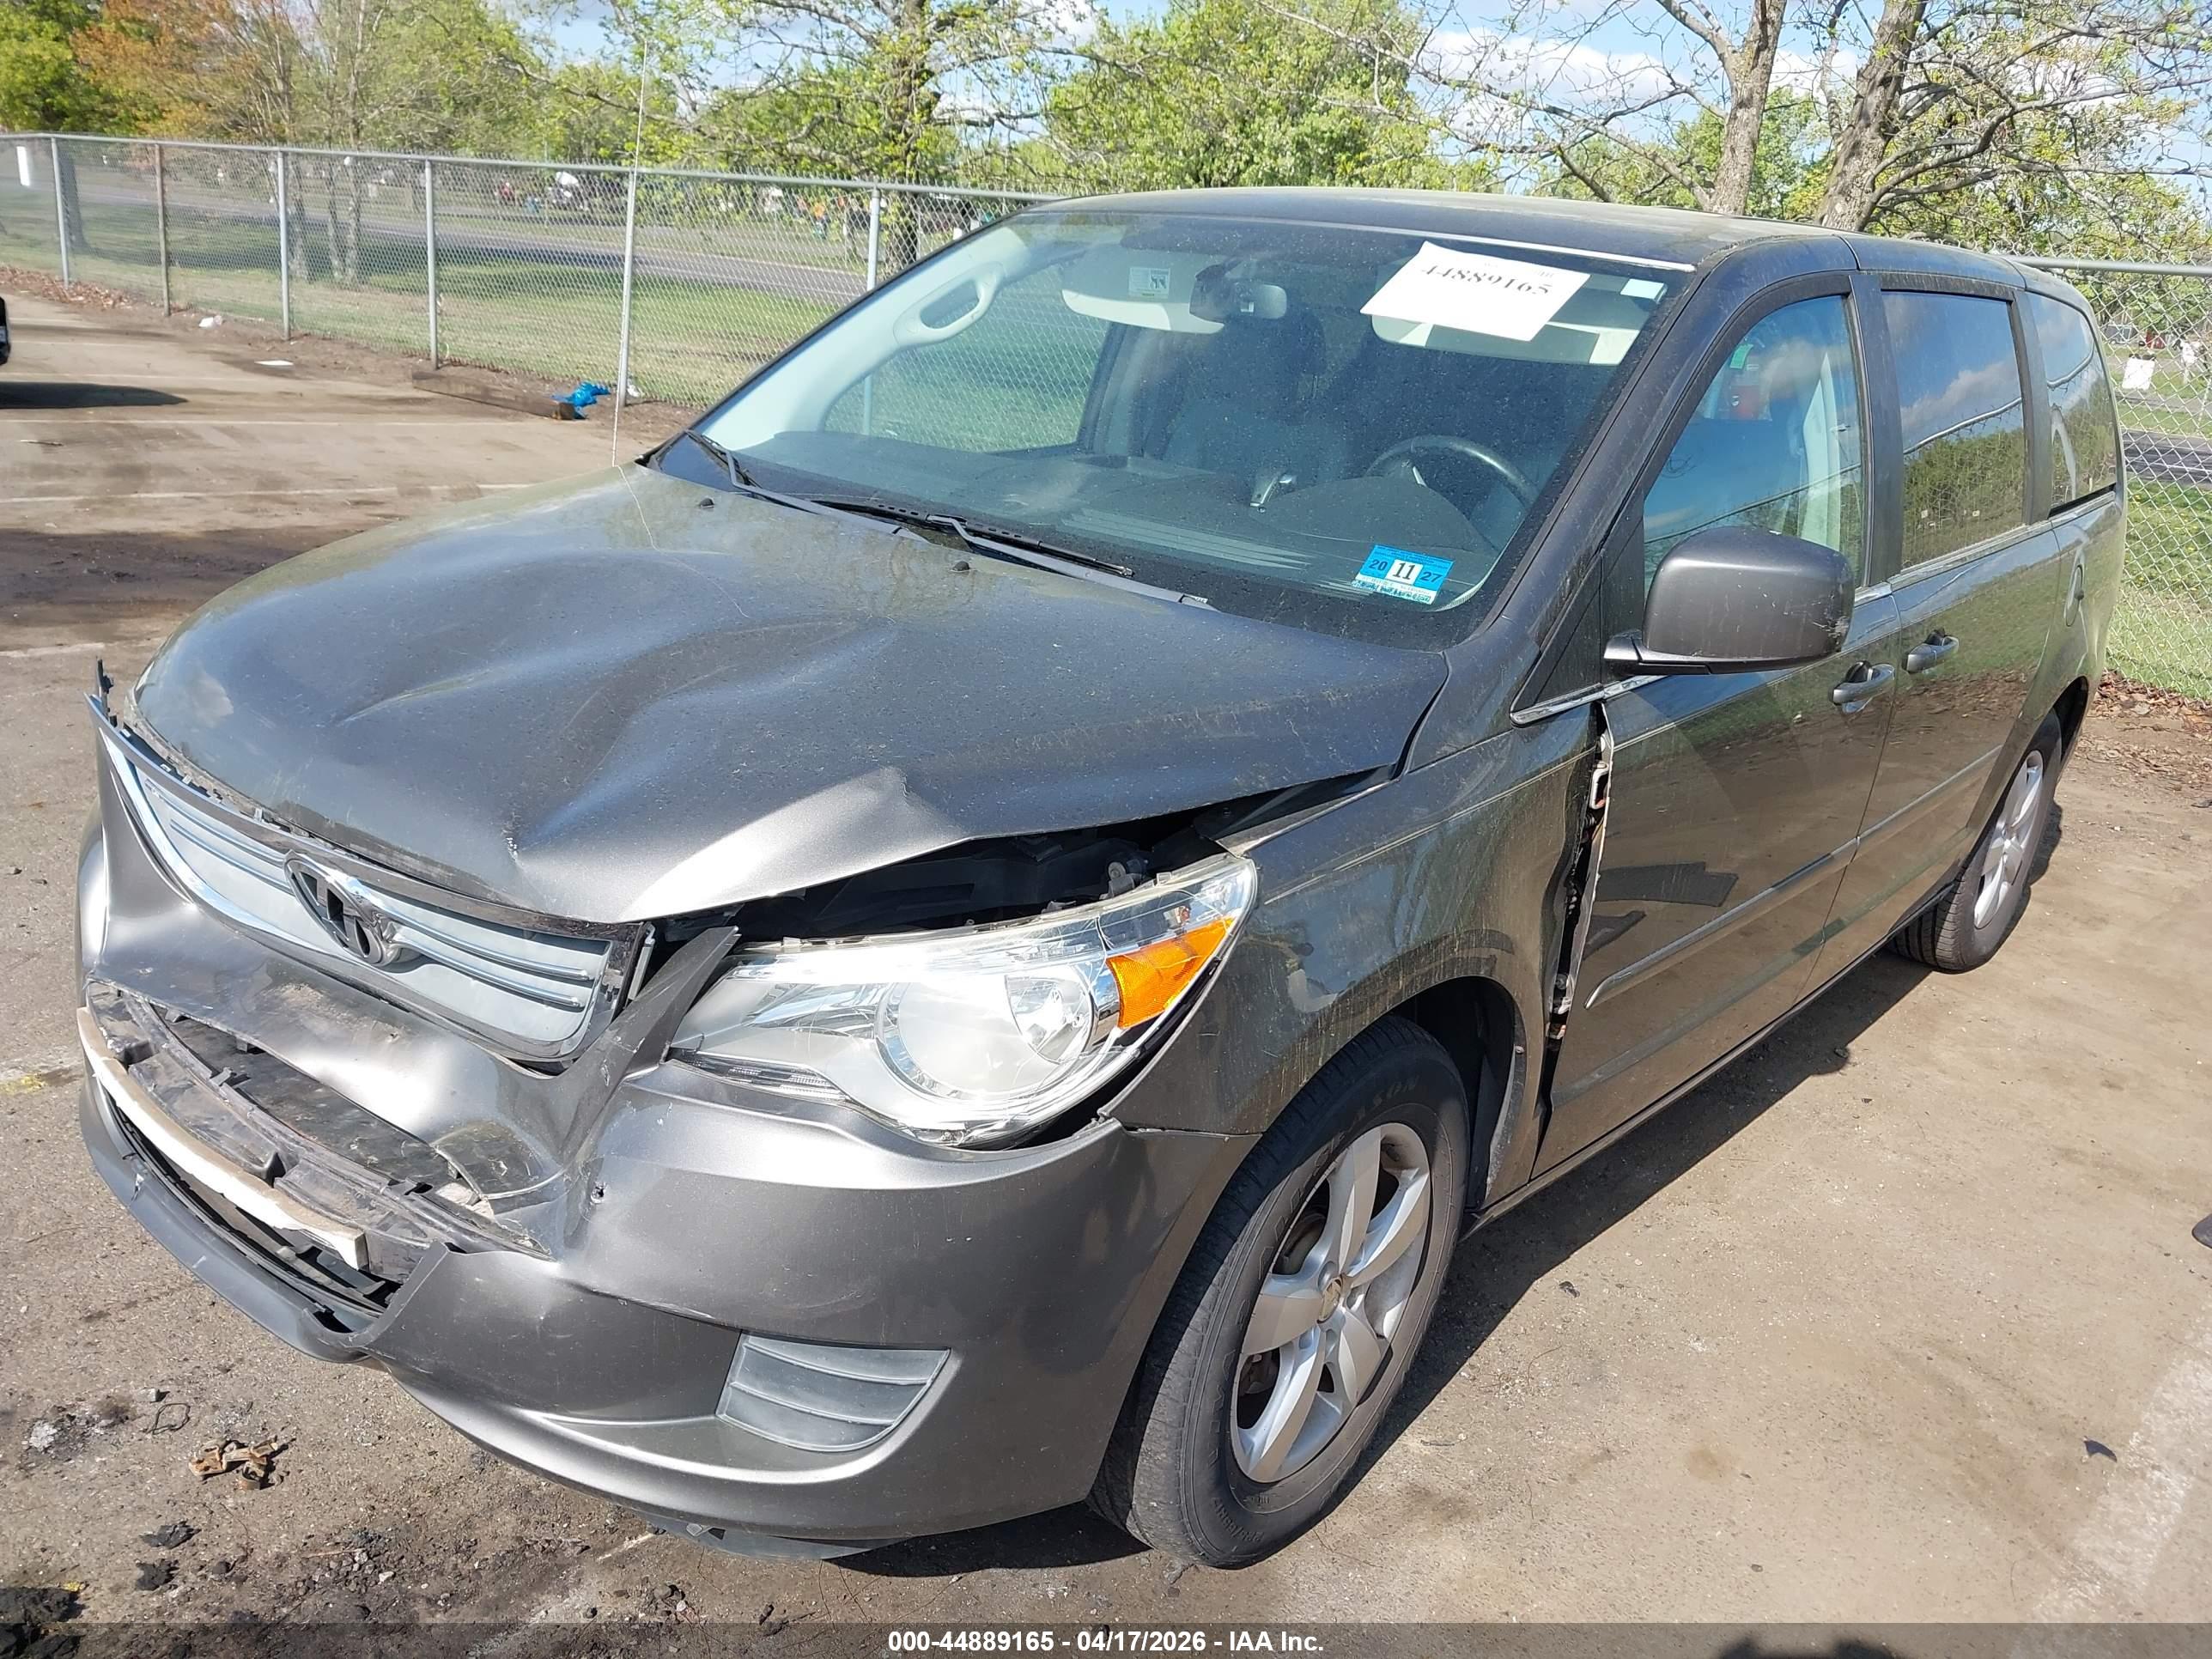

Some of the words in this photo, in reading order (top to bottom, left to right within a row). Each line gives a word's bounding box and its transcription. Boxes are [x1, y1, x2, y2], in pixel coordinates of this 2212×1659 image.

[1369, 559, 1389, 571] 20
[1393, 562, 1416, 580] 11
[1420, 571, 1443, 583] 27
